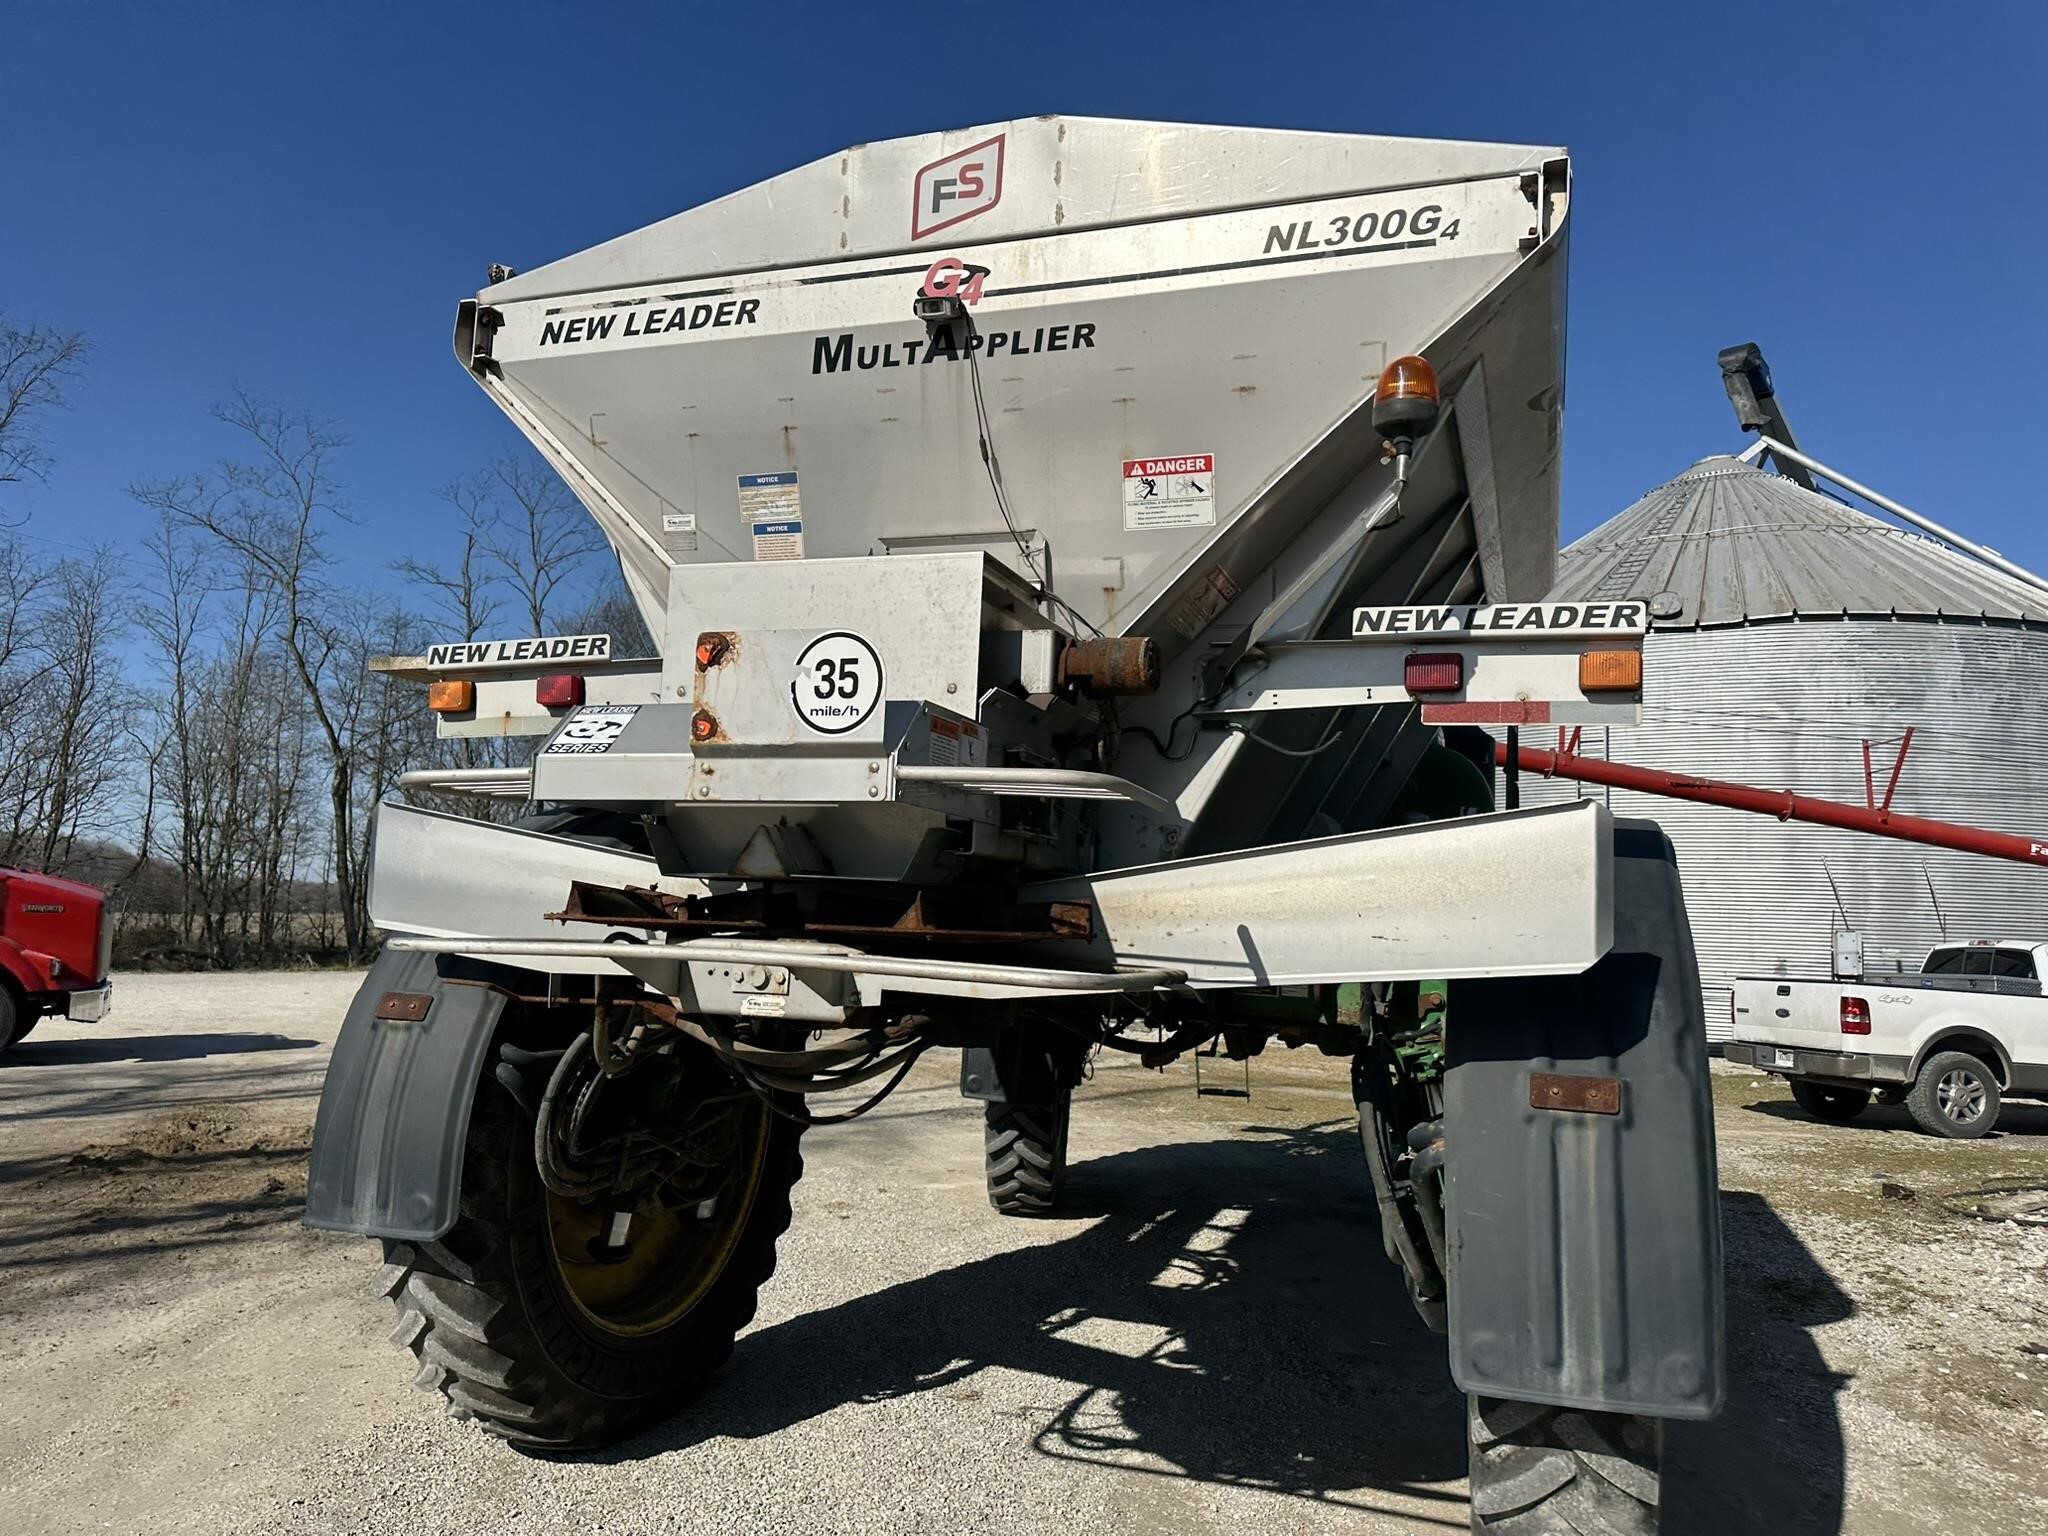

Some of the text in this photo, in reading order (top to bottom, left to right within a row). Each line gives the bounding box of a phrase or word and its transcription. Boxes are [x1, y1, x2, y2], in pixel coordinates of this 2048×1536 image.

[931, 162, 984, 214] FS
[1262, 204, 1462, 255] NL300G4
[923, 257, 985, 306] G4
[539, 298, 761, 346] NEW LEADER
[757, 476, 779, 484] NOTICE
[1145, 458, 1206, 474] DANGER
[1355, 604, 1642, 633] NEW LEADER
[429, 637, 608, 666] NEW LEADER
[813, 657, 859, 700] 35
[579, 705, 638, 714] NEW LEADER
[809, 705, 860, 717] mile/h
[547, 743, 610, 754] SERIES
